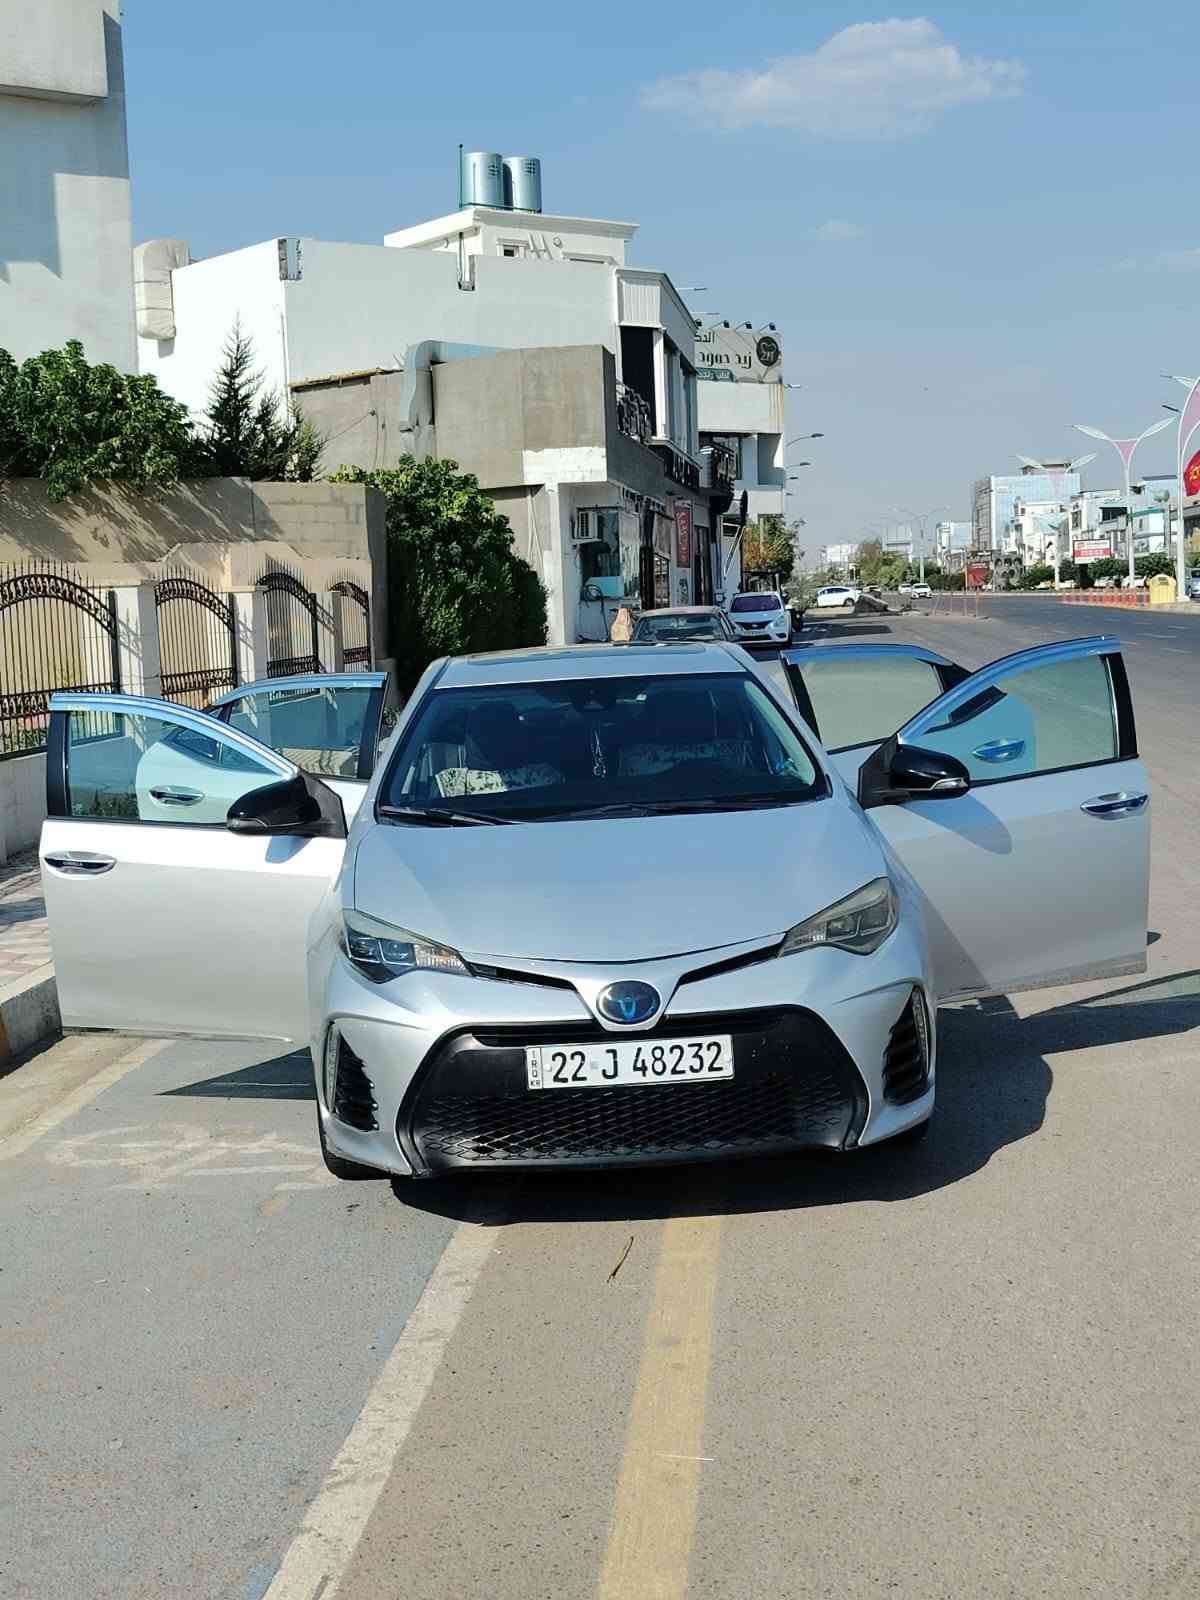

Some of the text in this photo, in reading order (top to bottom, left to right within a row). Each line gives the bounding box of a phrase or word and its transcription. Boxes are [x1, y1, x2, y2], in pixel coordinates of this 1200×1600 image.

[735, 352, 752, 369] زيد
[551, 1041, 724, 1083] 22 J 48232
